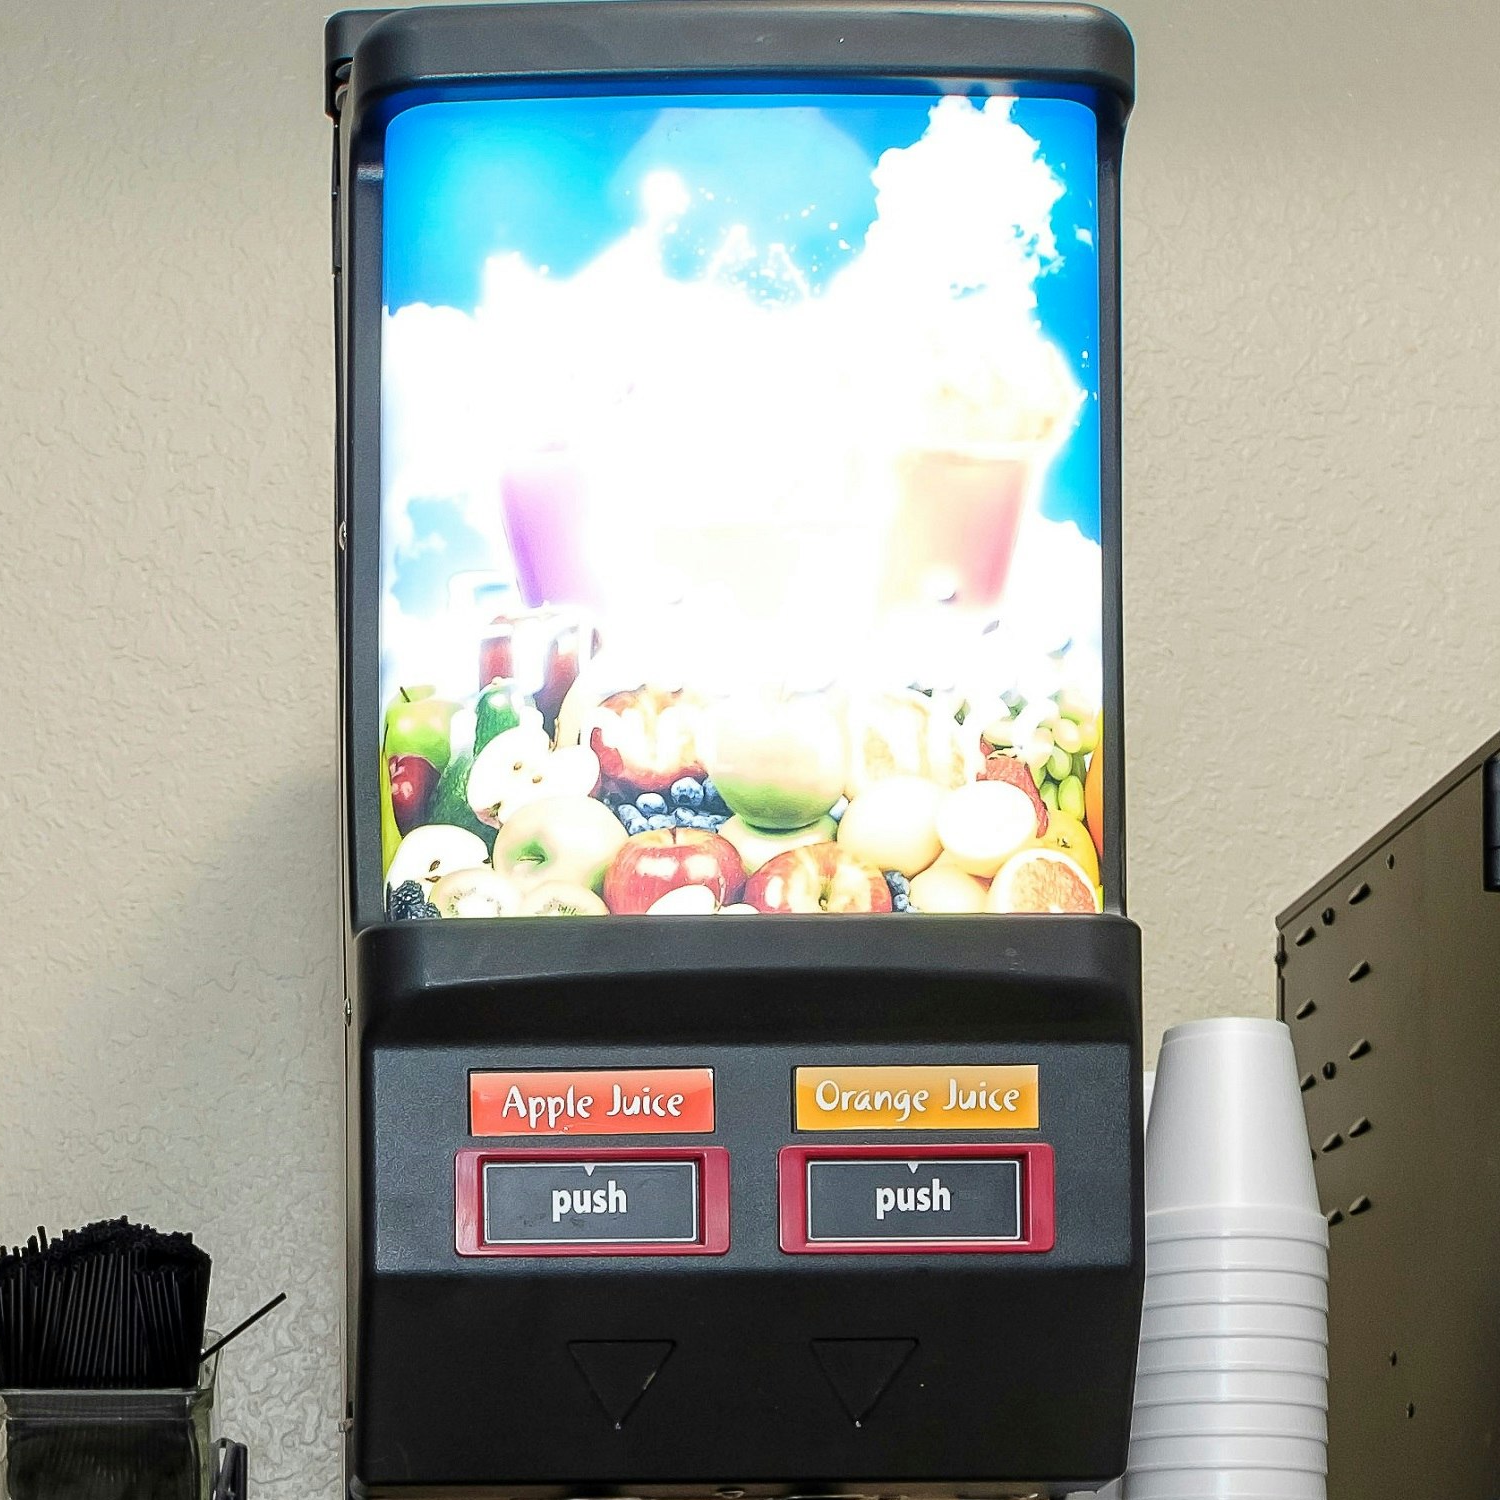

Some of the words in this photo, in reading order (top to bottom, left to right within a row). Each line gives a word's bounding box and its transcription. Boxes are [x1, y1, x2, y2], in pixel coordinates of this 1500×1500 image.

[502, 1084, 593, 1129] Apple
[606, 1083, 684, 1118] Juice
[815, 1079, 929, 1123] Orange
[942, 1078, 1020, 1112] Juice
[552, 1179, 627, 1222] push
[875, 1178, 951, 1220] push
